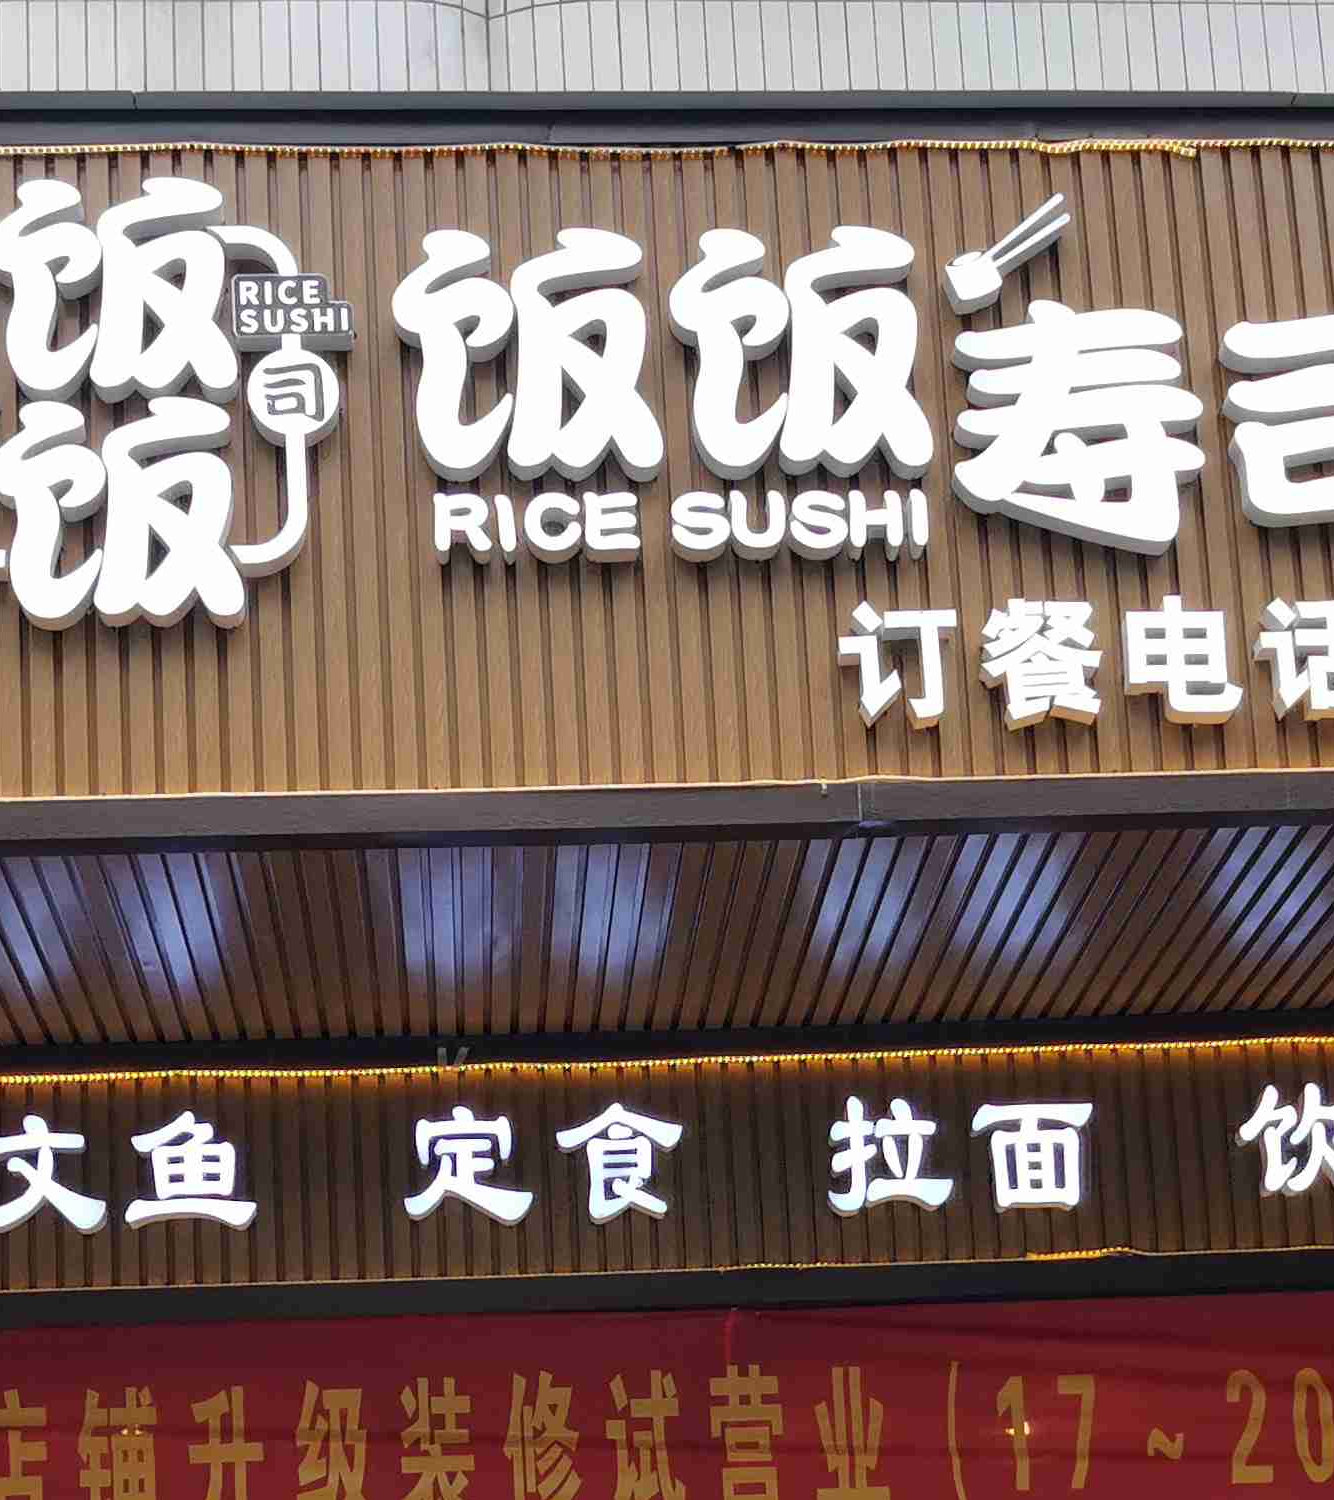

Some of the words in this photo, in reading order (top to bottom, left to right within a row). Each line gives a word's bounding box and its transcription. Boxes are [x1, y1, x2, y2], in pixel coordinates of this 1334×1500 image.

[238, 278, 321, 306] RICE
[239, 308, 350, 334] SUSHI
[433, 490, 642, 565] RICE
[670, 487, 931, 564] SUSHI
[402, 1102, 683, 1226] 定食
[827, 1095, 1094, 1218] 拉面
